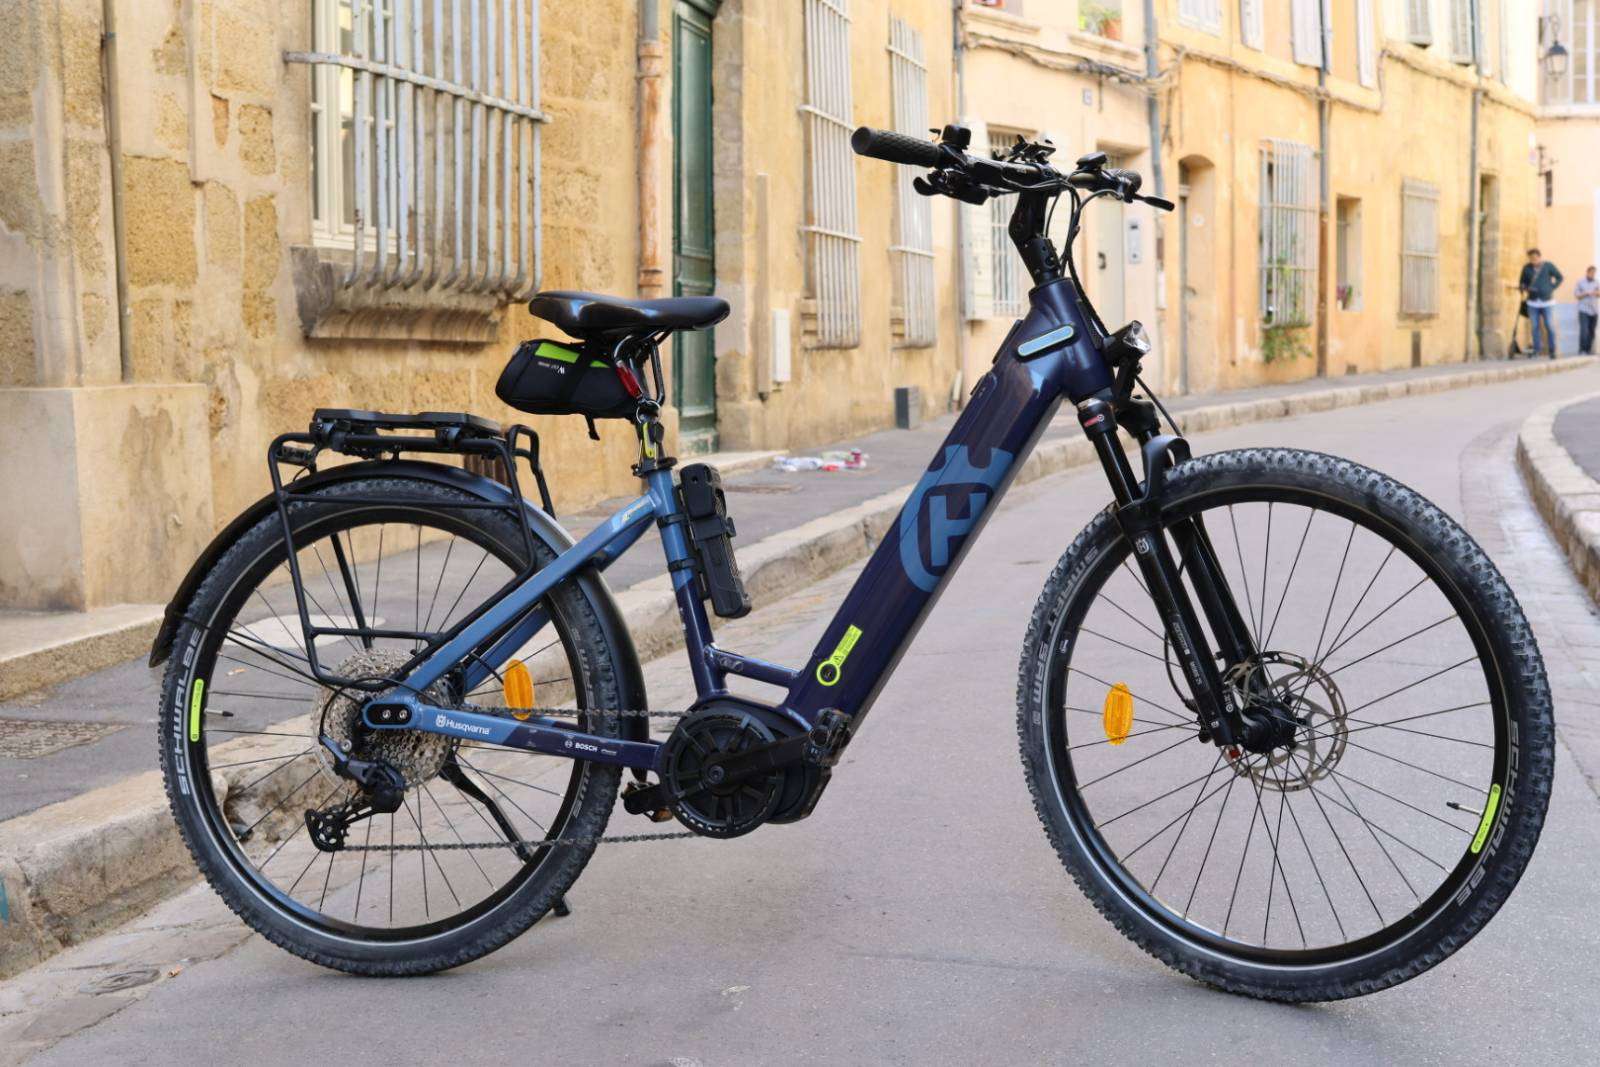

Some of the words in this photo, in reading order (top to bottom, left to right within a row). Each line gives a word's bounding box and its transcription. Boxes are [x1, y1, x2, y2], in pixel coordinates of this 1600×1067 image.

[1048, 546, 1099, 629] SMART
[1033, 641, 1049, 703] SAM
[173, 627, 202, 796] SCHWALBE
[445, 719, 490, 735] Husqvarna
[575, 742, 598, 752] BOSCH
[1456, 719, 1520, 907] SCHWALBE
